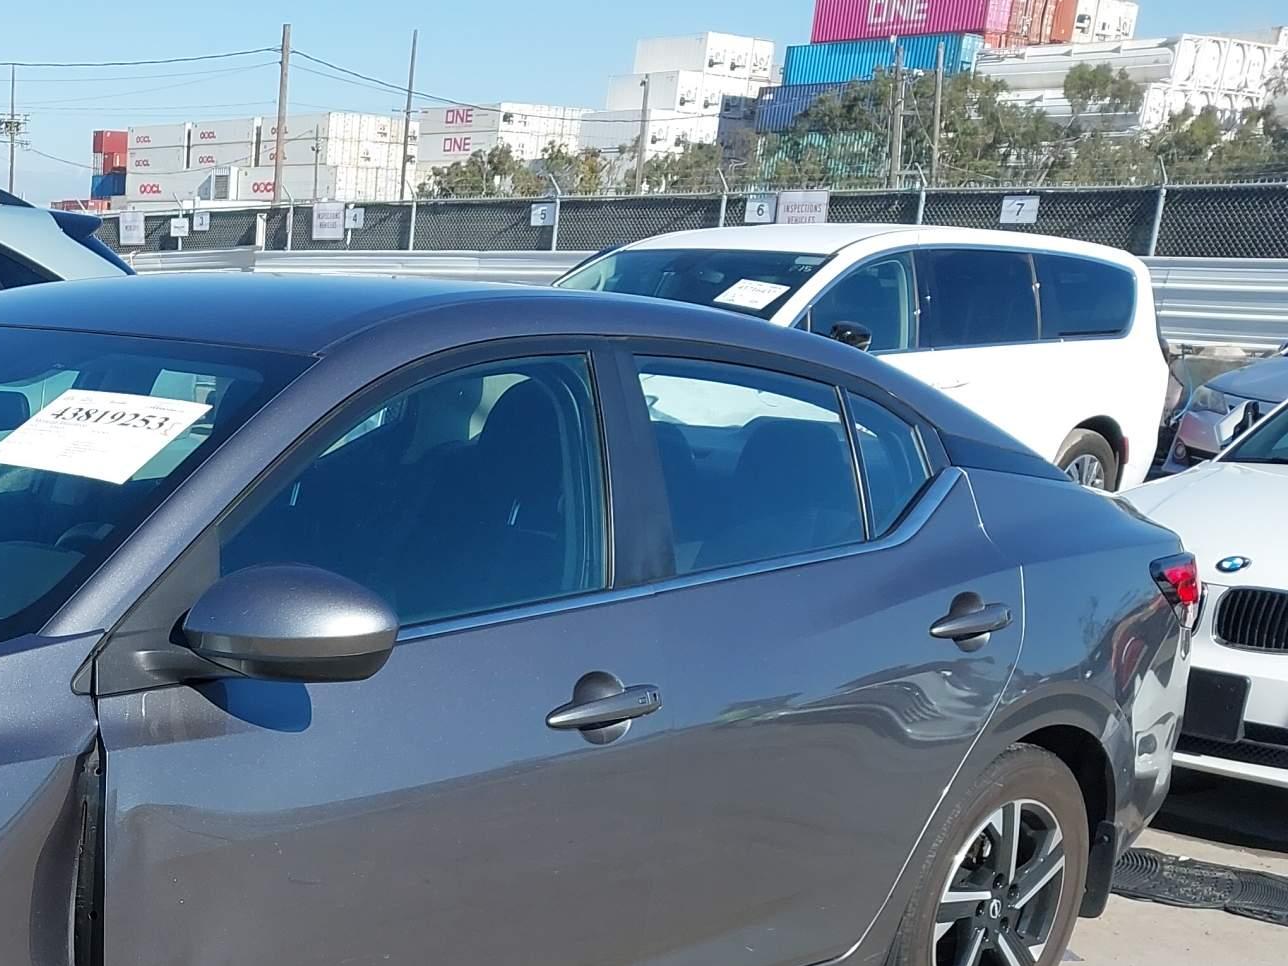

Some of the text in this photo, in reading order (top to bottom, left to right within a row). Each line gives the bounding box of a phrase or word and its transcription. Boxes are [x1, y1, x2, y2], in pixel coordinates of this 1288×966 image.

[445, 109, 473, 124] ONE
[443, 137, 471, 152] ONE
[139, 183, 161, 194] OOCL
[540, 209, 547, 220] 5
[756, 204, 765, 216] 6
[1016, 203, 1025, 216] 7
[352, 213, 358, 222] 4
[51, 406, 170, 430] 43819253
